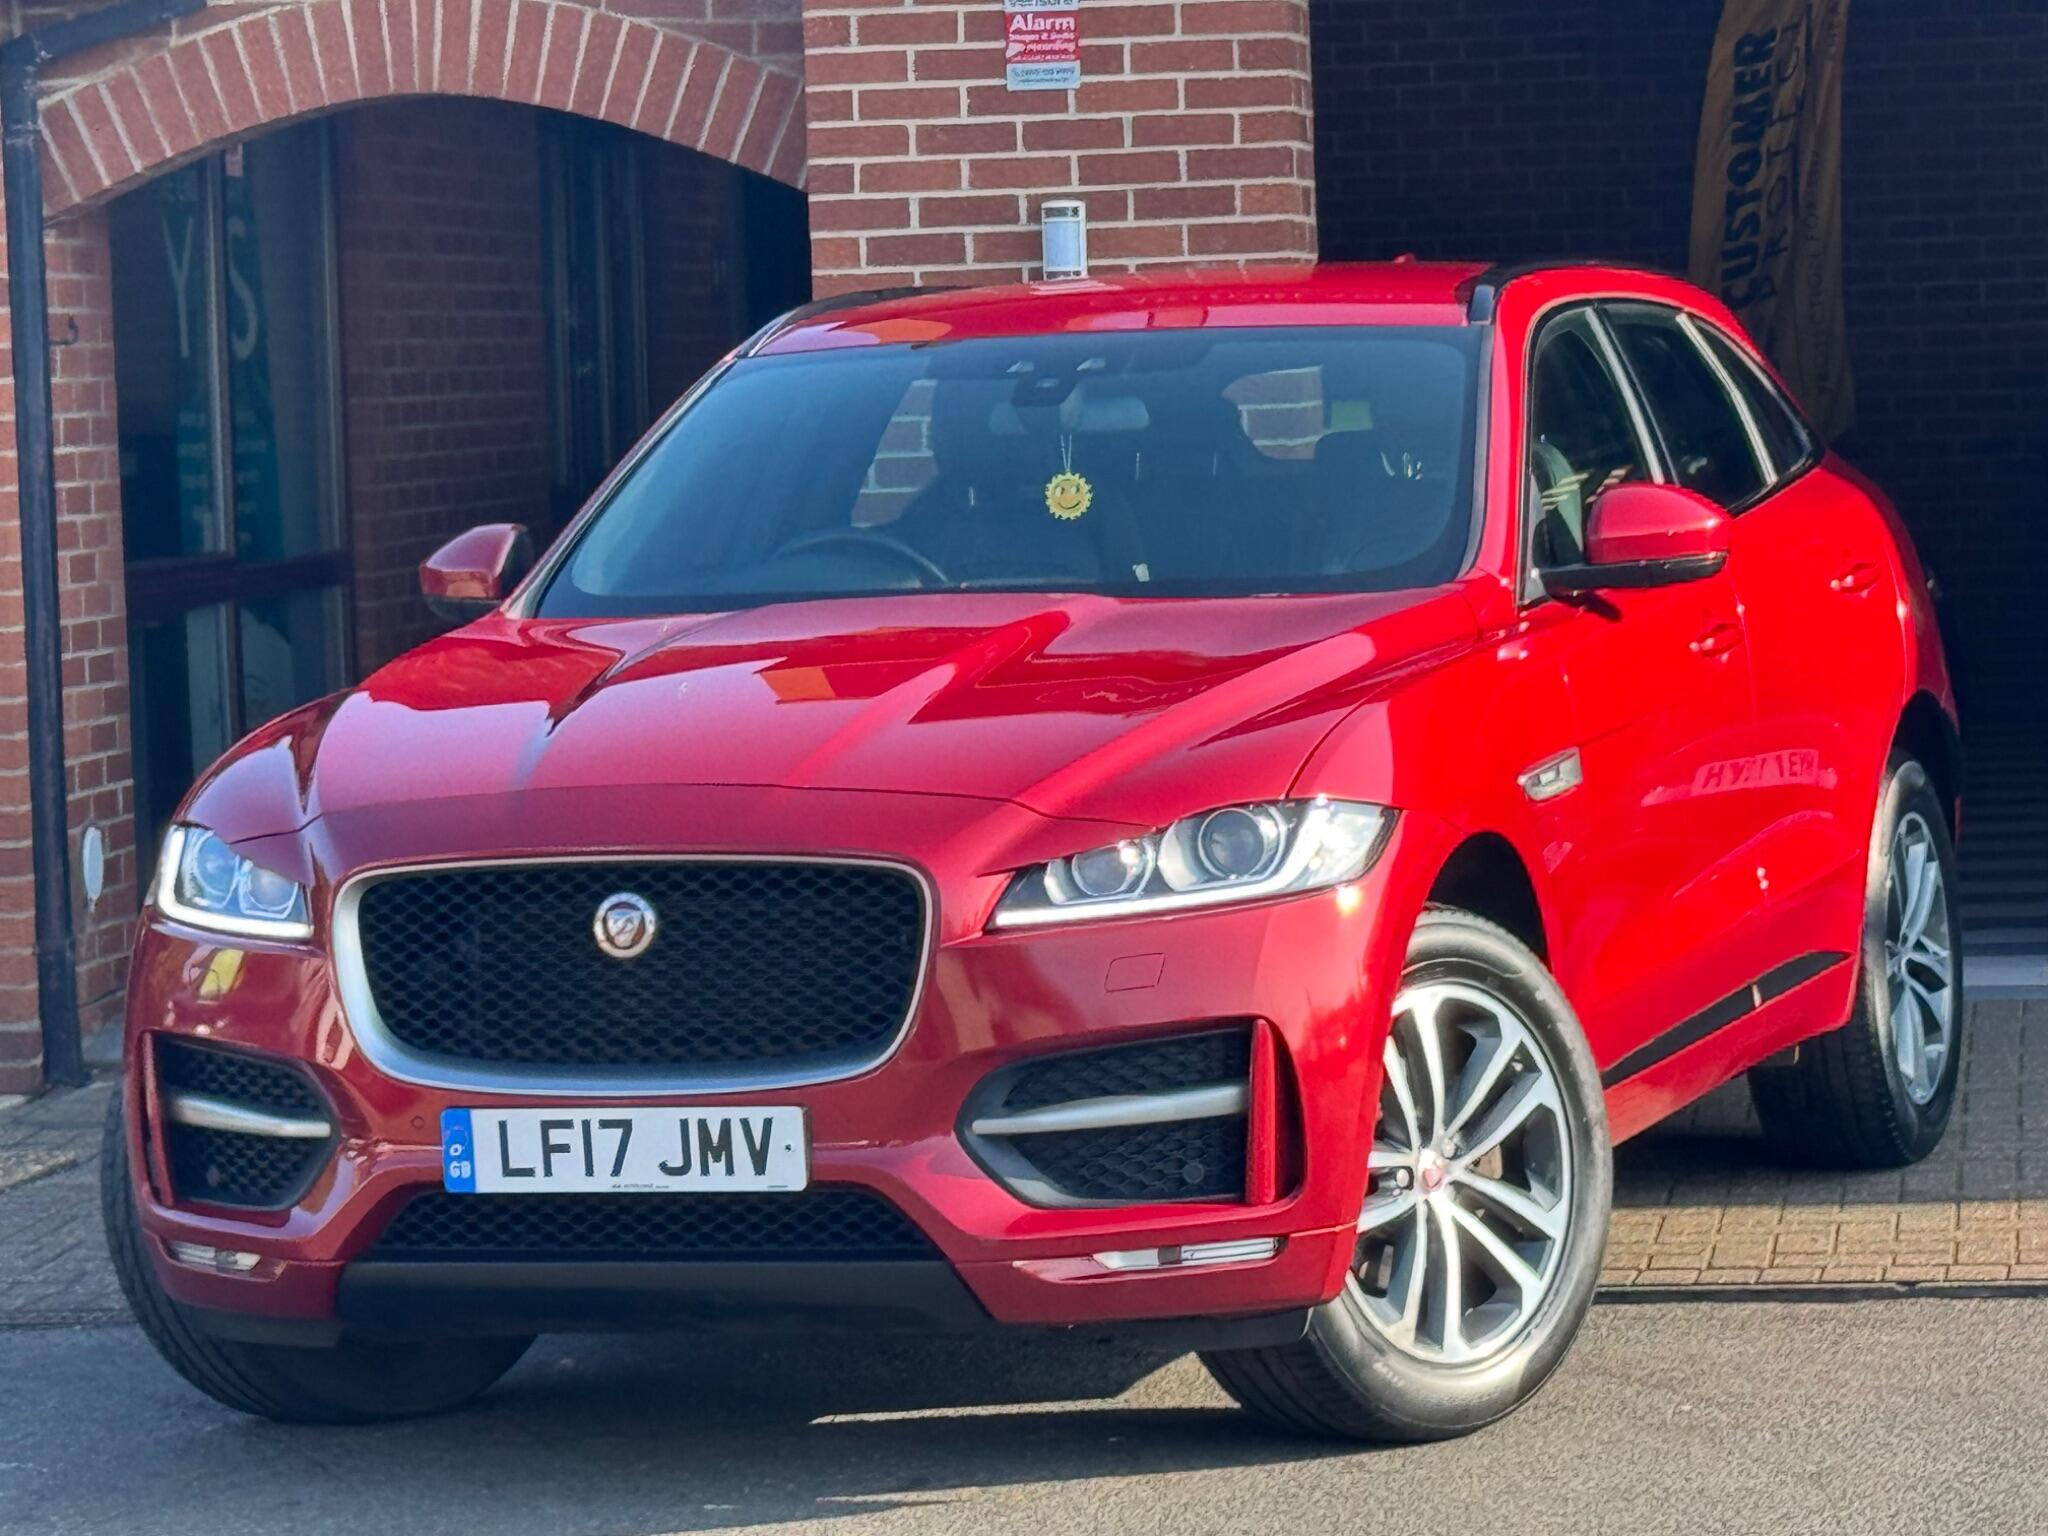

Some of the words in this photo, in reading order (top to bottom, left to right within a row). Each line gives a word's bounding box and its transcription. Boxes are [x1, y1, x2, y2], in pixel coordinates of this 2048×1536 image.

[1009, 13, 1076, 31] Alarm
[1720, 26, 1778, 311] CUSTOMER
[497, 1118, 634, 1178] LF17
[657, 1116, 775, 1178] JMV
[449, 1160, 472, 1179] GB
